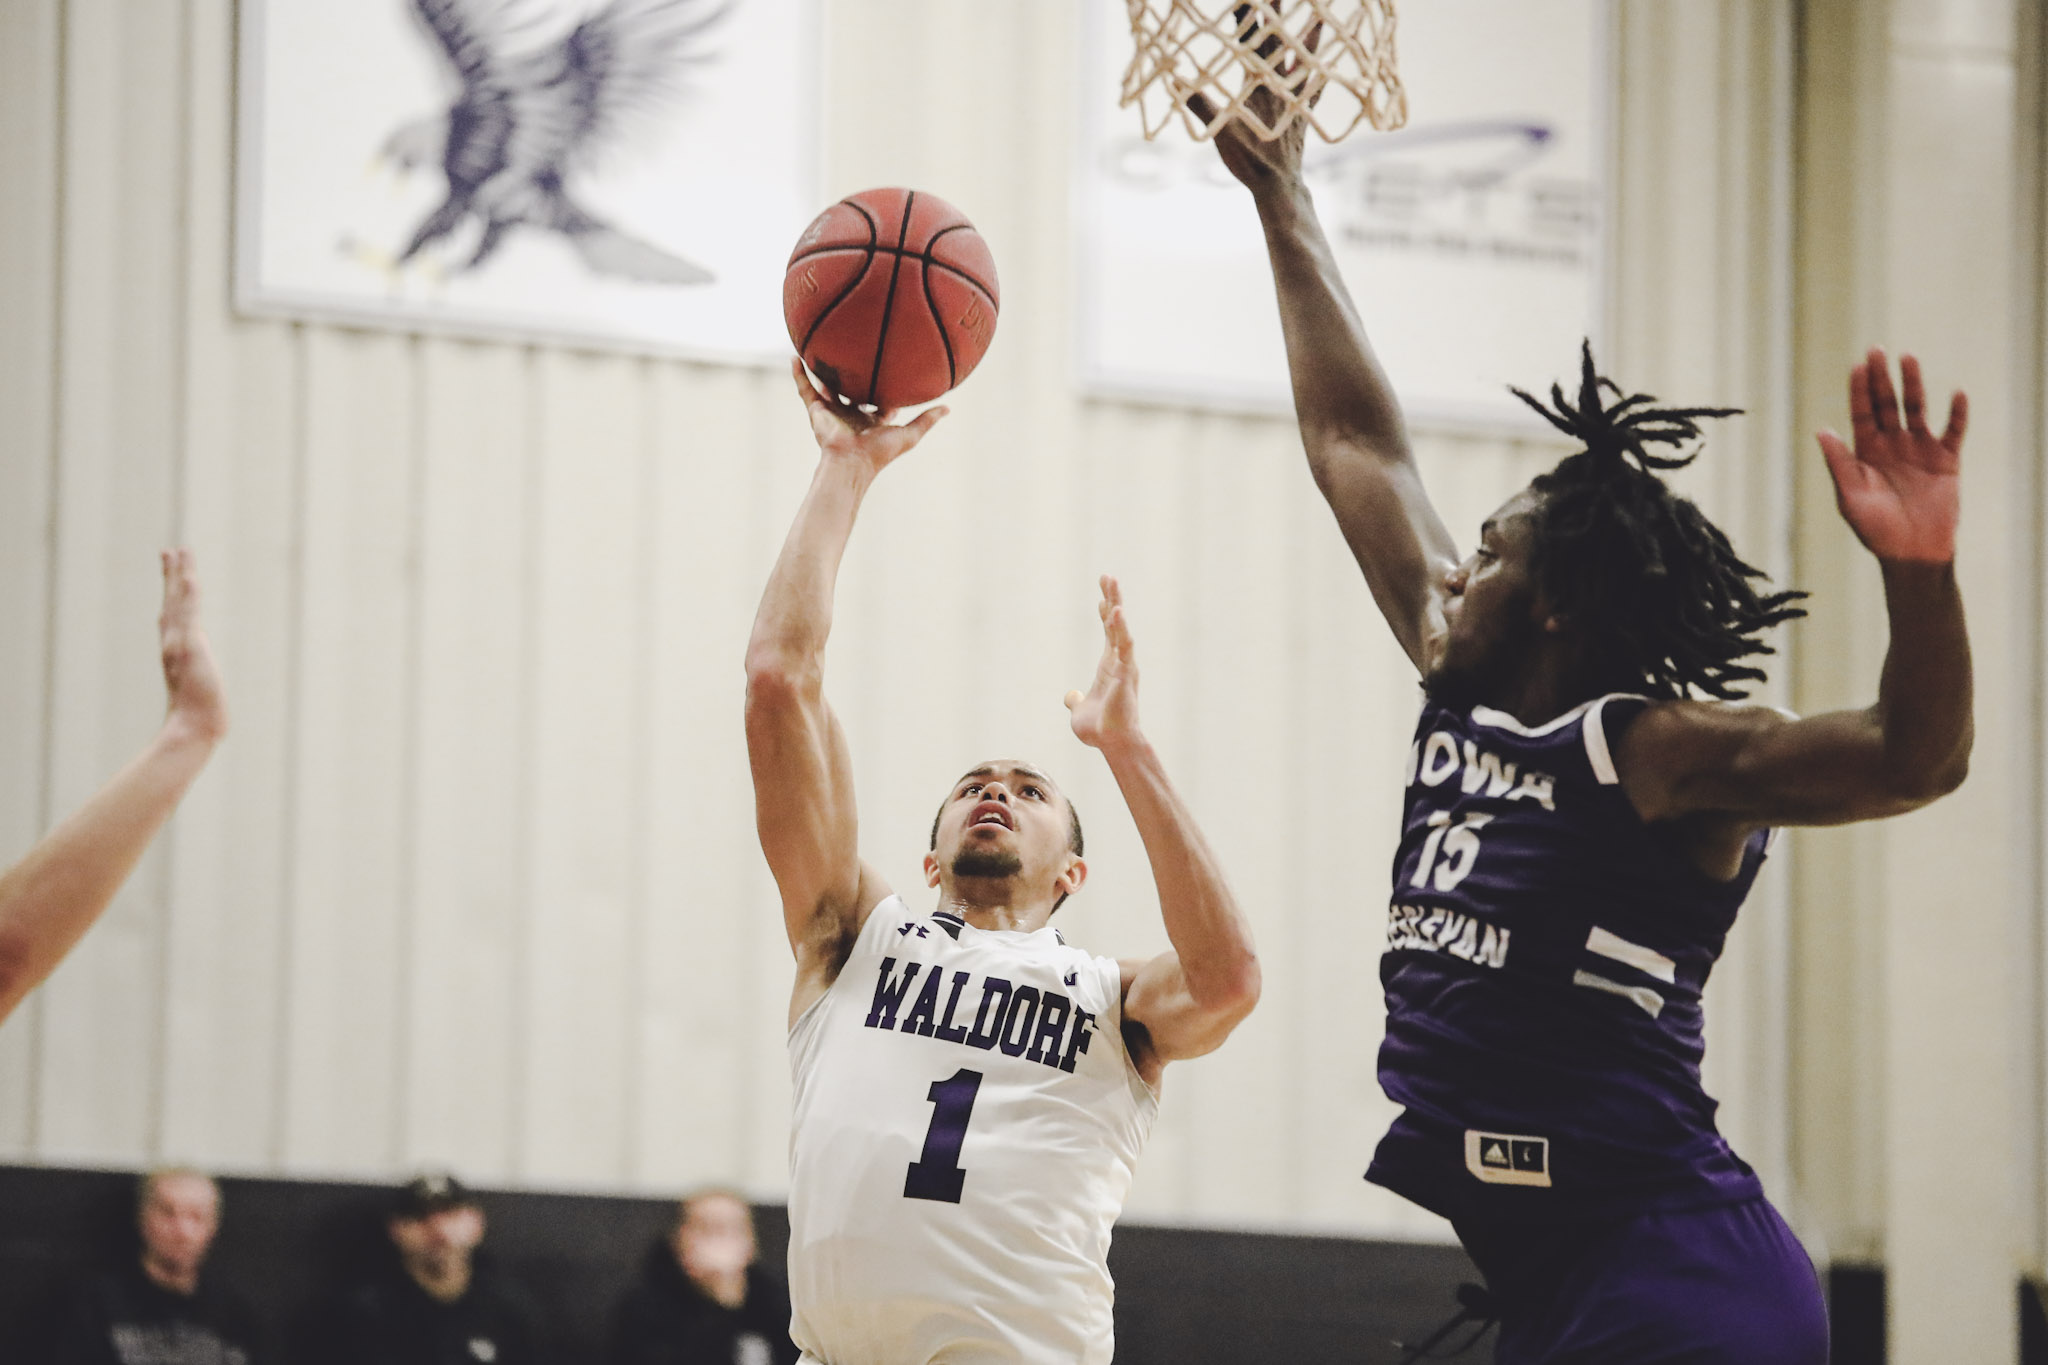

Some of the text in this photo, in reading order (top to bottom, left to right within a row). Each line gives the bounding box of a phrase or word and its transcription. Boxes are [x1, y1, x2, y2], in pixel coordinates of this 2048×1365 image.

[1410, 811, 1495, 892] 15
[864, 957, 1099, 1074] WALDORF
[903, 1068, 983, 1204] 1
